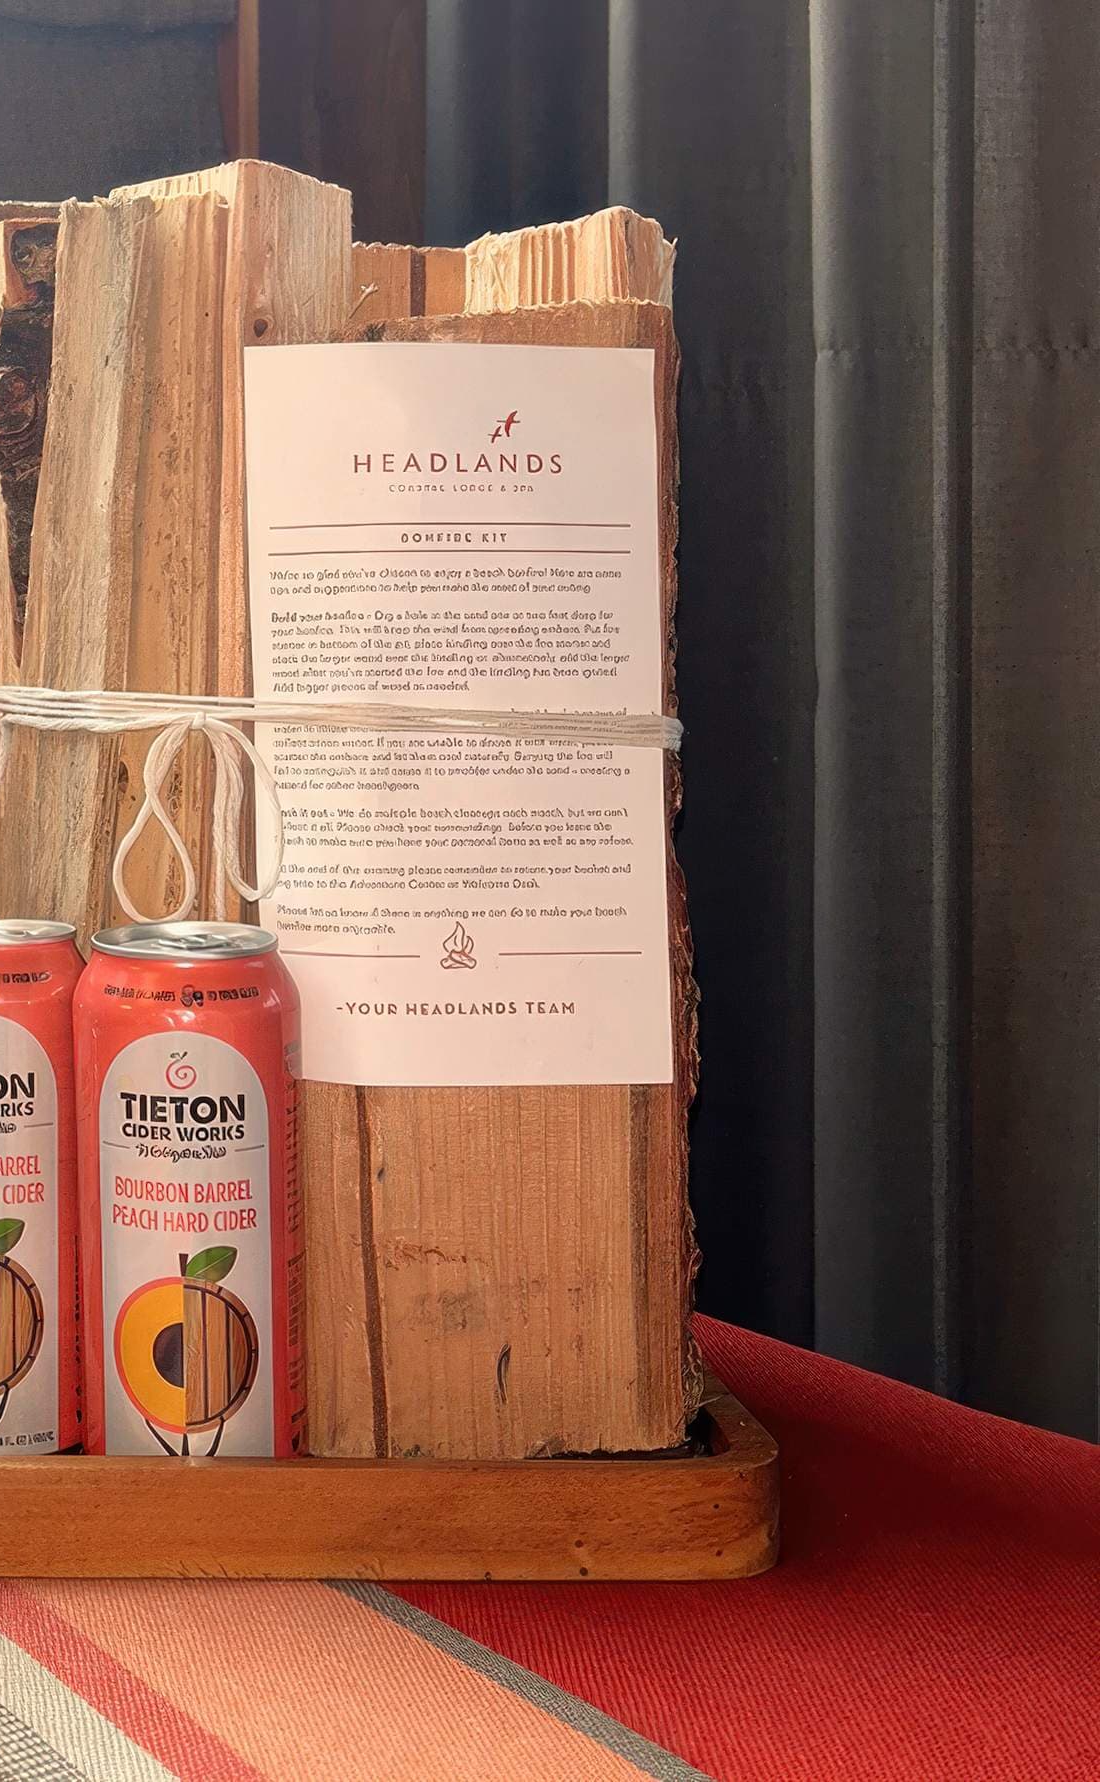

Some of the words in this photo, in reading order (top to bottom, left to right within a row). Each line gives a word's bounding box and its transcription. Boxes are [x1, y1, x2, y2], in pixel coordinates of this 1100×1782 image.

[354, 453, 562, 474] HEADLANDS
[482, 533, 507, 543] KIT
[406, 1002, 517, 1015] HEADLANDS
[527, 1001, 575, 1014] TEAM
[120, 1092, 245, 1124] TIETON
[122, 1122, 172, 1141] CIDER
[177, 1124, 245, 1142] WORKS
[3, 1183, 45, 1205] CIDER
[115, 1176, 189, 1203] BOURBON
[194, 1180, 253, 1203] BARREL
[112, 1206, 158, 1232] PEACH
[163, 1209, 208, 1233] HARD
[213, 1208, 257, 1230] CIDER
